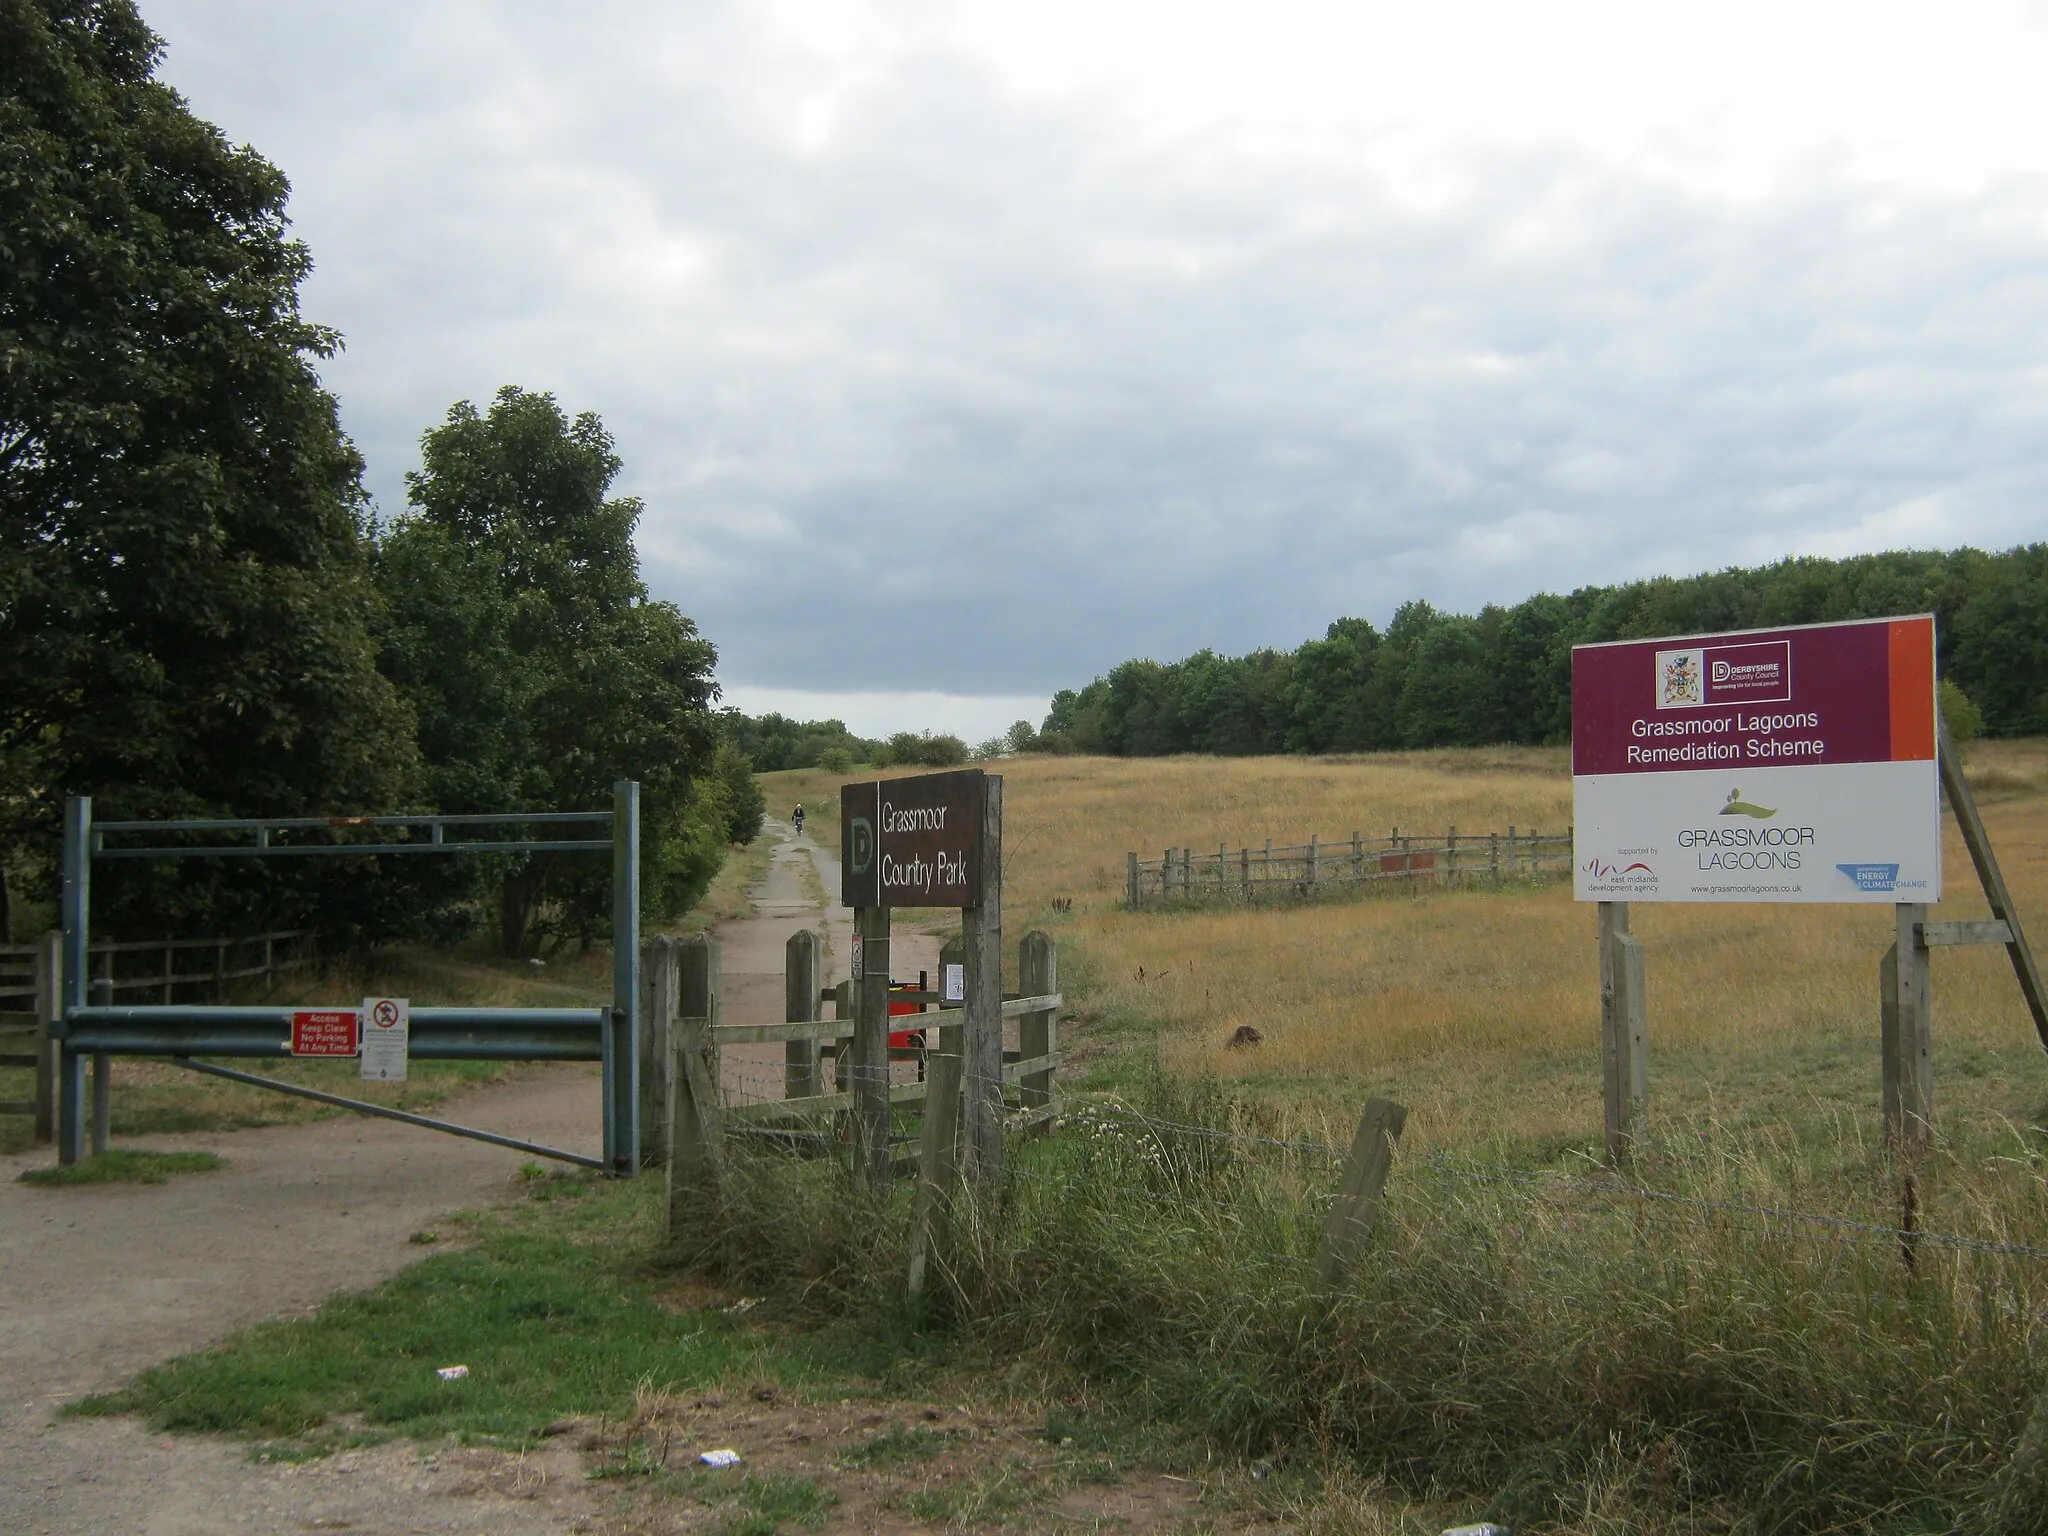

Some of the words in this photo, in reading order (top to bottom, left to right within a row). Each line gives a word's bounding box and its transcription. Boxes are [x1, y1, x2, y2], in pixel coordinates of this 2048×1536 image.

[1731, 663, 1779, 673] DERBYSHIRE
[1755, 671, 1779, 679] Council
[1631, 719, 1732, 737] Grassmoor
[1738, 712, 1818, 734] Lagoons
[1627, 742, 1740, 763] Remediation
[1746, 738, 1824, 757] Scheme
[882, 802, 947, 832] Grassmoor
[1677, 827, 1814, 847] GRASSMOOR
[1618, 847, 1649, 855] supported
[1650, 847, 1658, 855] by
[1698, 851, 1801, 870] LAGOONS
[882, 853, 933, 894] Country
[937, 850, 967, 886] Park
[1857, 872, 1889, 880] ENERGY
[1627, 875, 1659, 883] midlands
[1588, 884, 1632, 892] development
[1691, 884, 1801, 894] www.grassmoorlagoons.co.uk
[310, 1014, 340, 1022] Access
[301, 1024, 322, 1033] Keep
[325, 1024, 348, 1032] Clear
[301, 1034, 313, 1042] No
[316, 1034, 348, 1043] Parking
[311, 1044, 326, 1053] Any
[329, 1044, 349, 1052] Time
